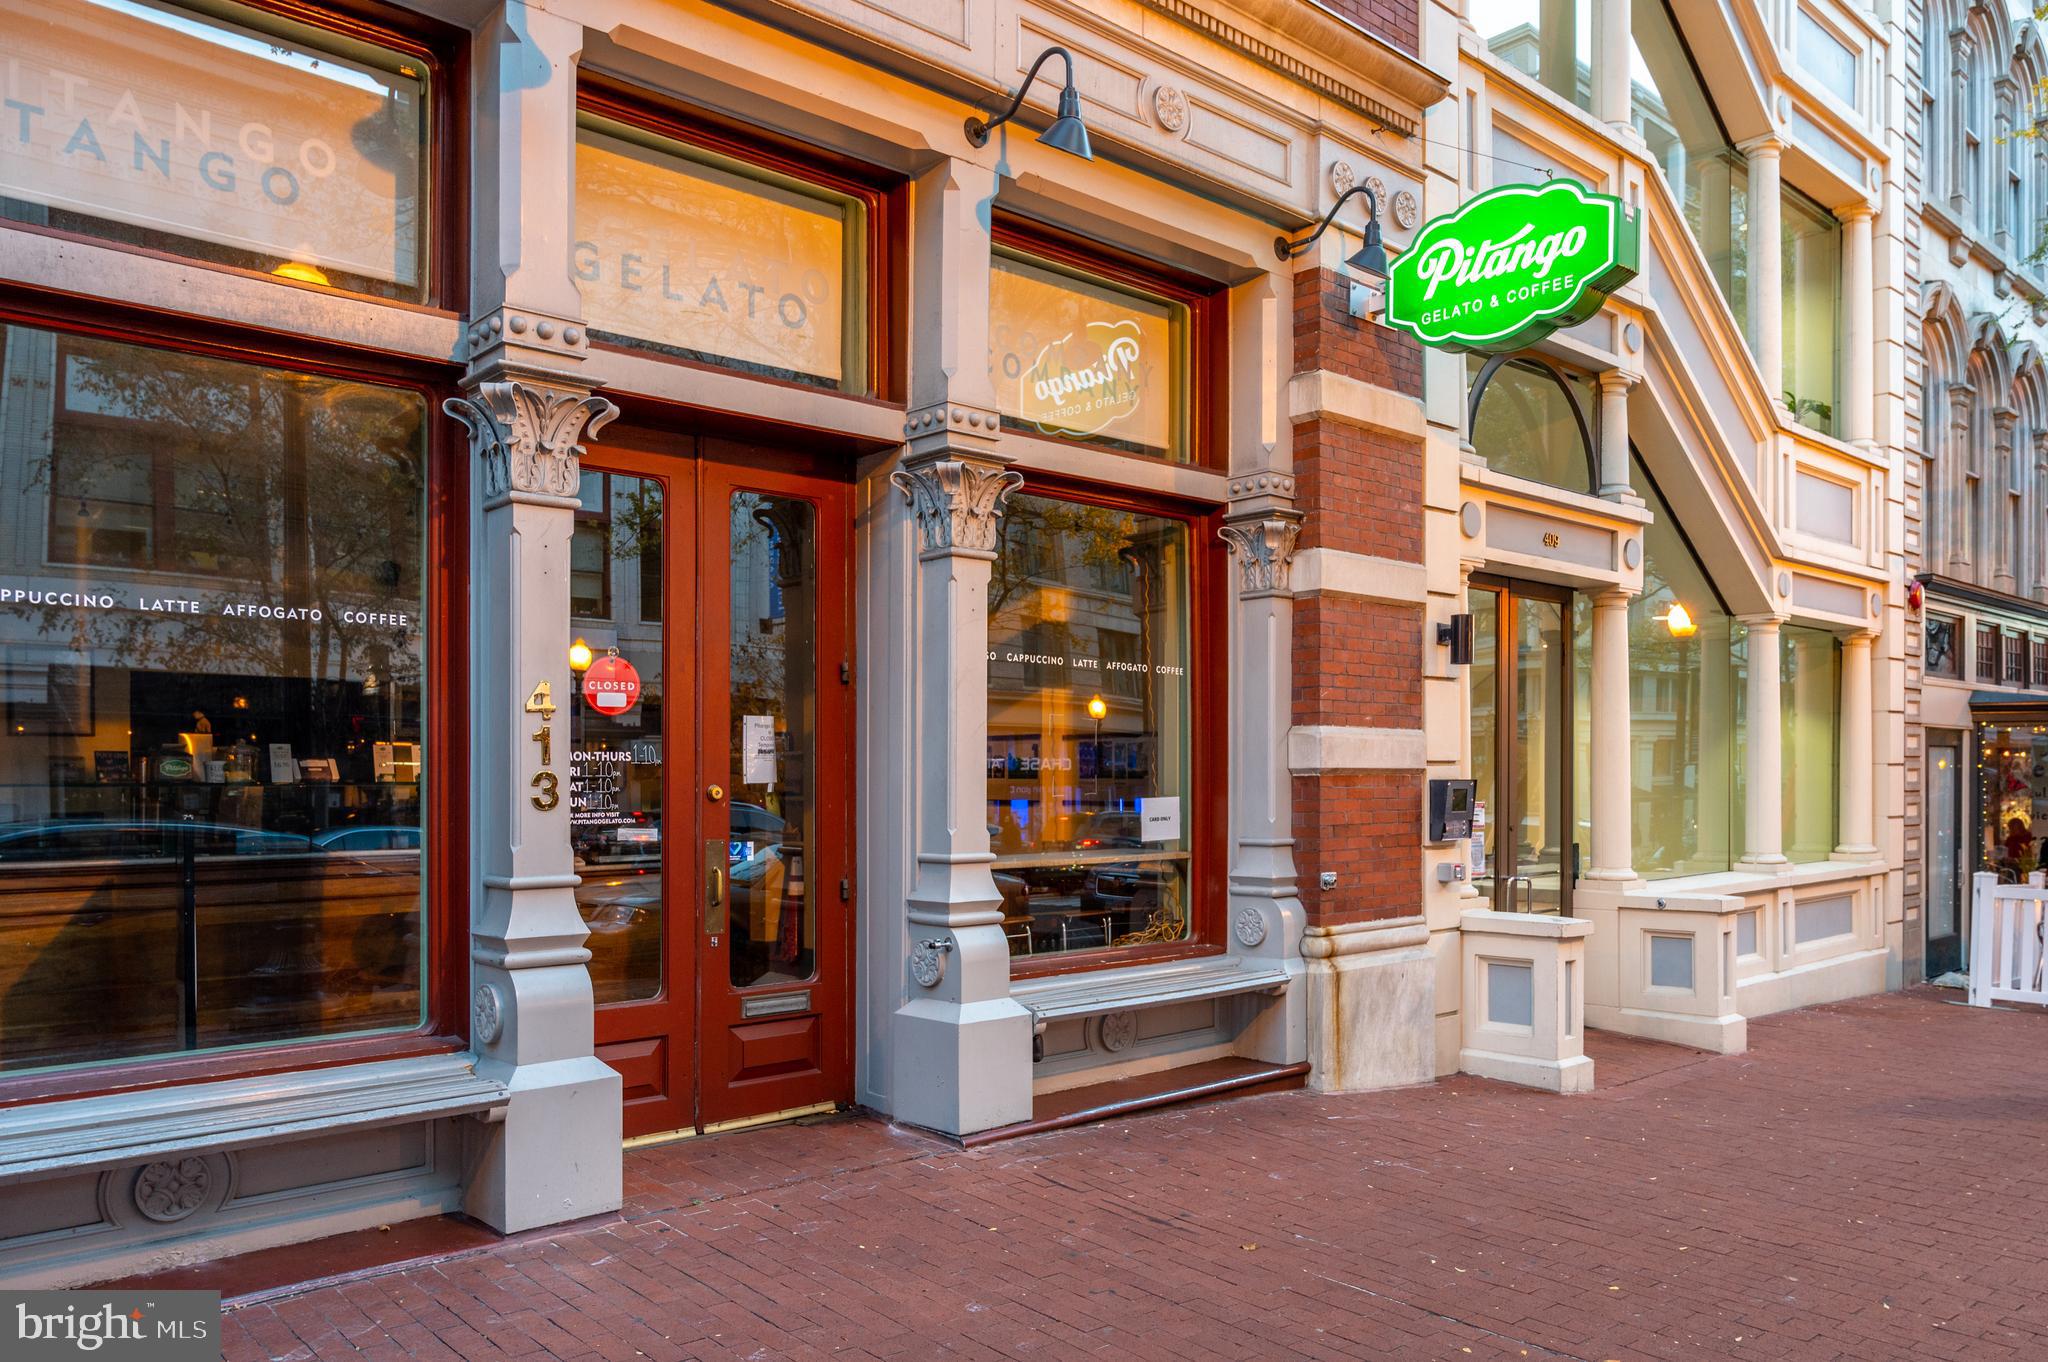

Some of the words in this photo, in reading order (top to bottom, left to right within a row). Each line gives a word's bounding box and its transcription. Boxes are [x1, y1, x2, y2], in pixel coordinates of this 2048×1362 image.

[1417, 223, 1588, 301] Pitango
[574, 241, 808, 329] GELATO
[1421, 299, 1483, 325] GELATO
[1489, 294, 1500, 308] &
[1506, 274, 1575, 304] COFFEE
[1543, 532, 1560, 548] 409
[0, 588, 115, 609] PPUCCINO
[139, 598, 200, 614] LATTE
[223, 604, 323, 622] AFFOGATO
[344, 611, 408, 626] COFFEE
[588, 680, 635, 691] CLOSED
[1006, 653, 1064, 666] CAPPUCCINO
[1072, 658, 1098, 669] LATTE
[1106, 661, 1148, 673] AFFOGATO
[1156, 665, 1184, 676] COFFEE
[524, 679, 560, 812] 413
